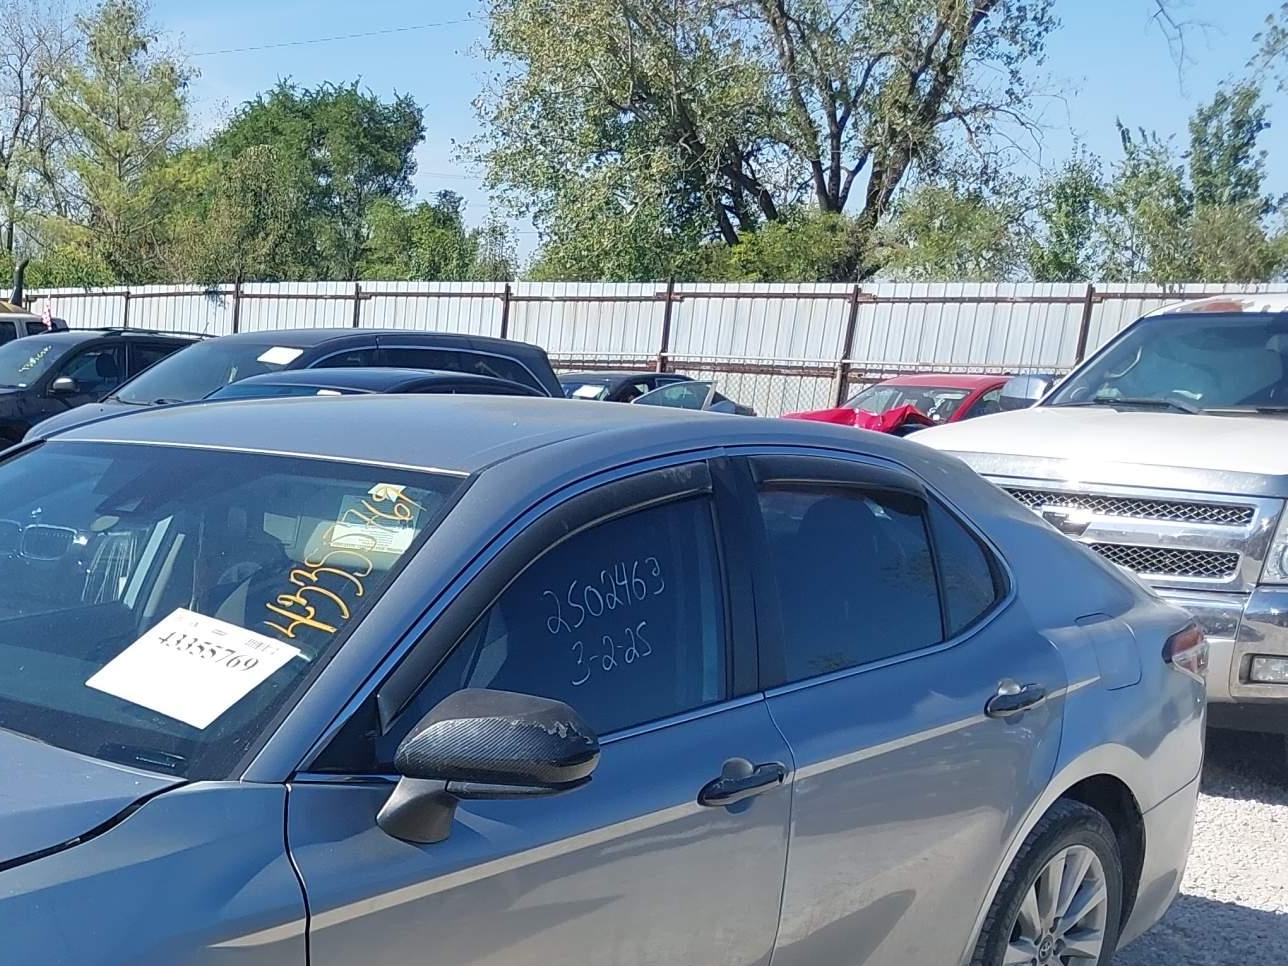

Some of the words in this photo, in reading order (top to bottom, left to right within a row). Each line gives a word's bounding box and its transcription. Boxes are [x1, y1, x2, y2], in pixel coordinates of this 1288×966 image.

[543, 557, 665, 634] 2502463
[158, 631, 260, 671] 43355769
[572, 620, 653, 686] 3-2-25
